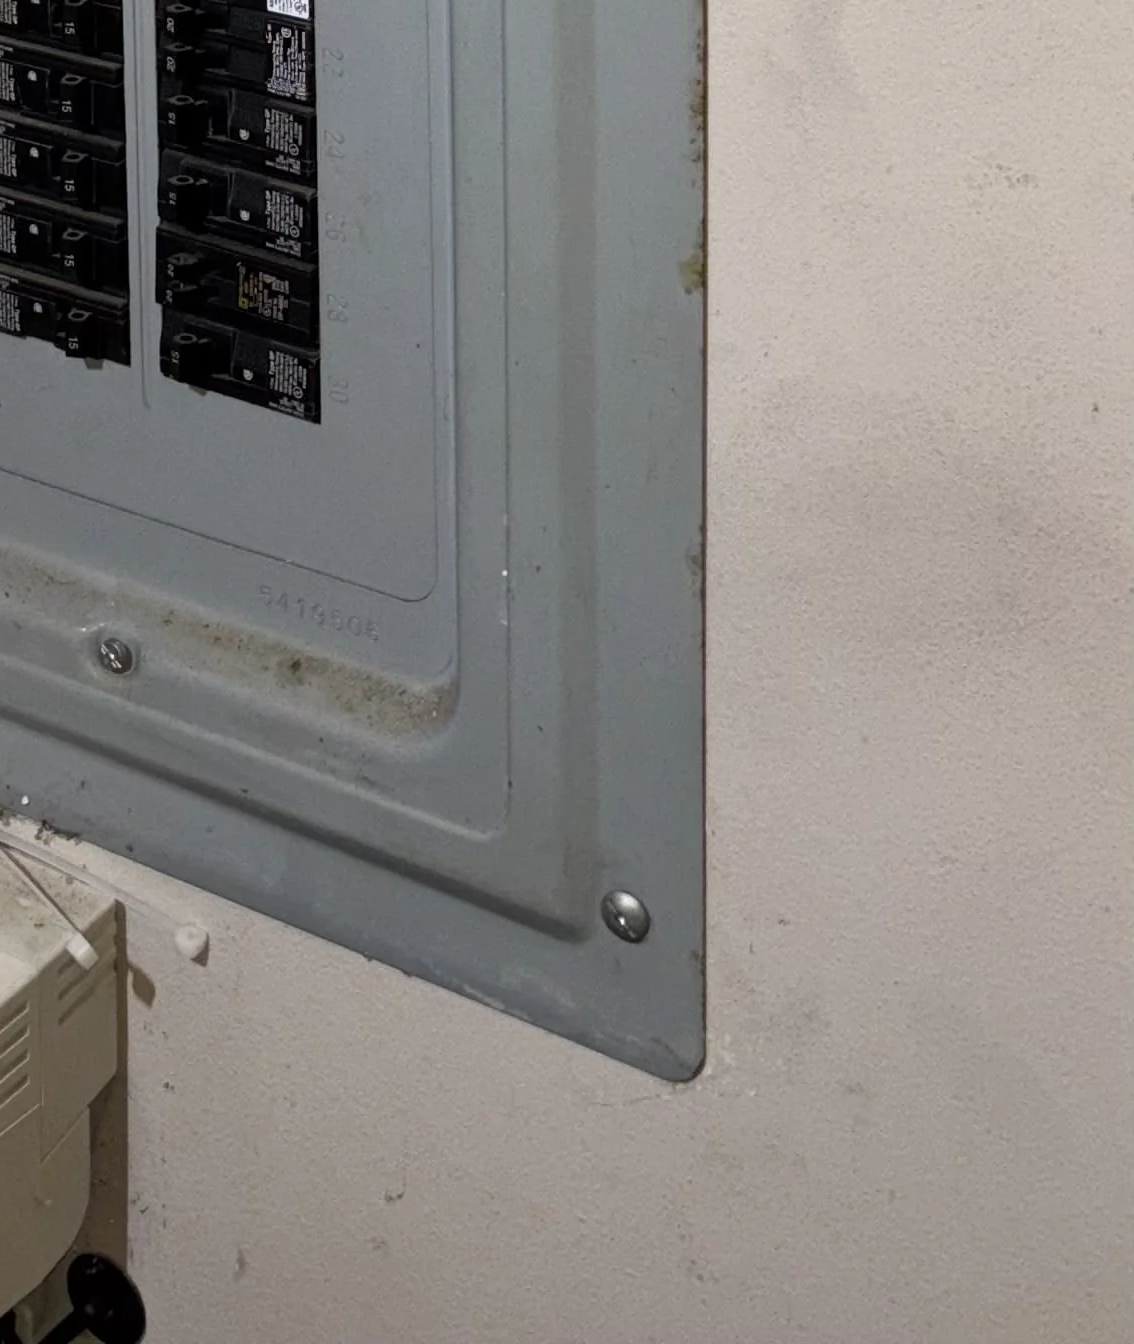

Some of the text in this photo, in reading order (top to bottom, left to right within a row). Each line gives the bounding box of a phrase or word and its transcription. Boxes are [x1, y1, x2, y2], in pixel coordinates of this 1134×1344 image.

[65, 22, 76, 35] 15
[62, 100, 73, 113] 15
[65, 180, 76, 192] 15
[64, 254, 75, 267] 15
[68, 337, 79, 350] 15
